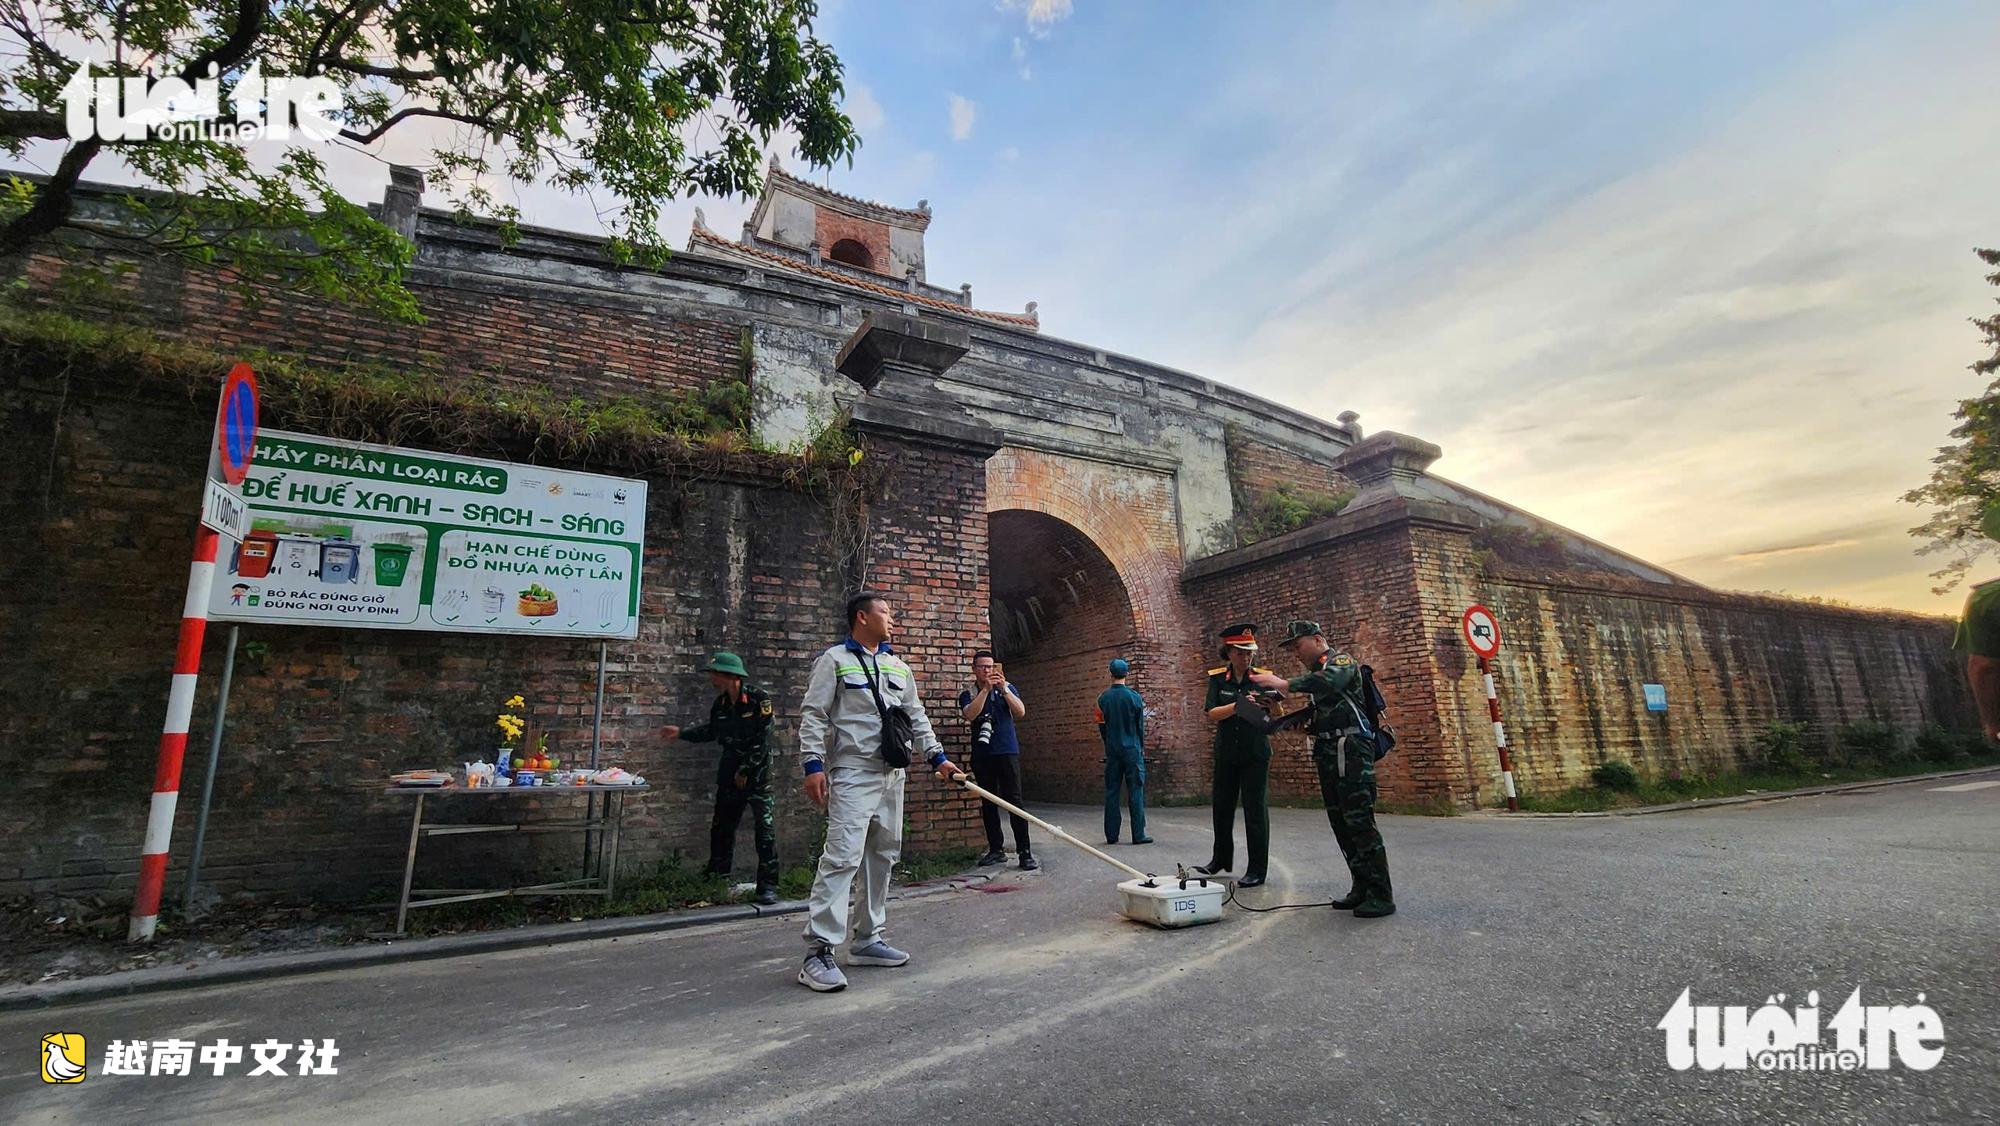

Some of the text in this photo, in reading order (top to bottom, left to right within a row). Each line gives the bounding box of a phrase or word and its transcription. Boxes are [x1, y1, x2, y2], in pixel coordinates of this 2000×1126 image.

[252, 445, 308, 464] HÃY
[314, 453, 386, 474] PHÂN
[393, 463, 448, 483] LOẠI
[455, 470, 500, 488] RÁC
[216, 493, 239, 531] 100m
[242, 472, 287, 500] ĐỂ
[288, 481, 353, 507] HUẾ
[354, 490, 432, 516] XANH
[462, 503, 533, 527] SẠCH
[561, 512, 625, 536] SÁNG
[466, 541, 607, 563] HẠN CHẾ DÙNG
[448, 553, 623, 581] ĐỒ NHỰA MỘT LẦN
[264, 600, 399, 615] ĐÚNG NƠI QUY ĐỊNH
[267, 587, 386, 604] BỎ RÁC ĐÚNG GIỜ
[1175, 899, 1196, 911] IDS
